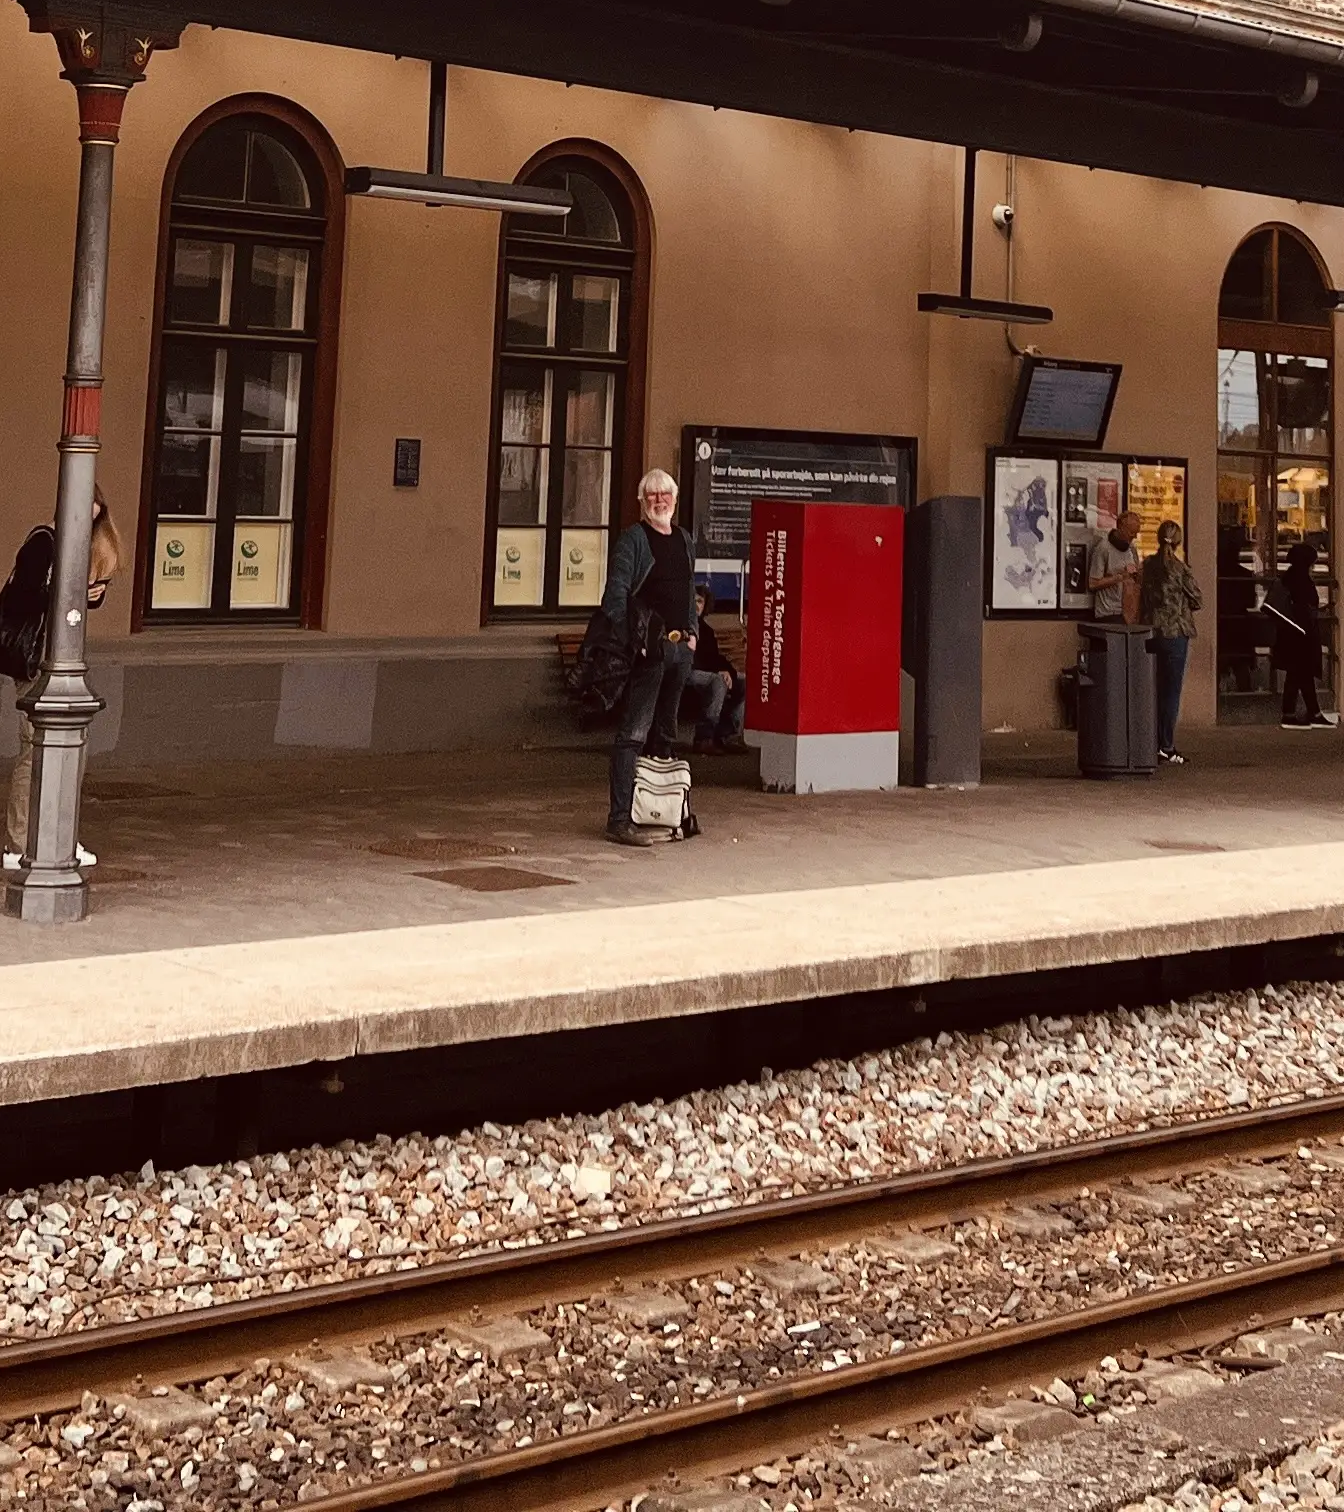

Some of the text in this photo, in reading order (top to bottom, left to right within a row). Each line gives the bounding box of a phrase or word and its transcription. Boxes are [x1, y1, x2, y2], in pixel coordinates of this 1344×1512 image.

[830, 471, 843, 482] kan
[162, 560, 185, 576] Lime
[237, 560, 259, 576] Lime
[502, 565, 522, 580] Lime
[566, 566, 584, 580] Lime
[771, 530, 787, 685] Billetter & Togafgange
[761, 530, 776, 703] Tickets & Train departures
